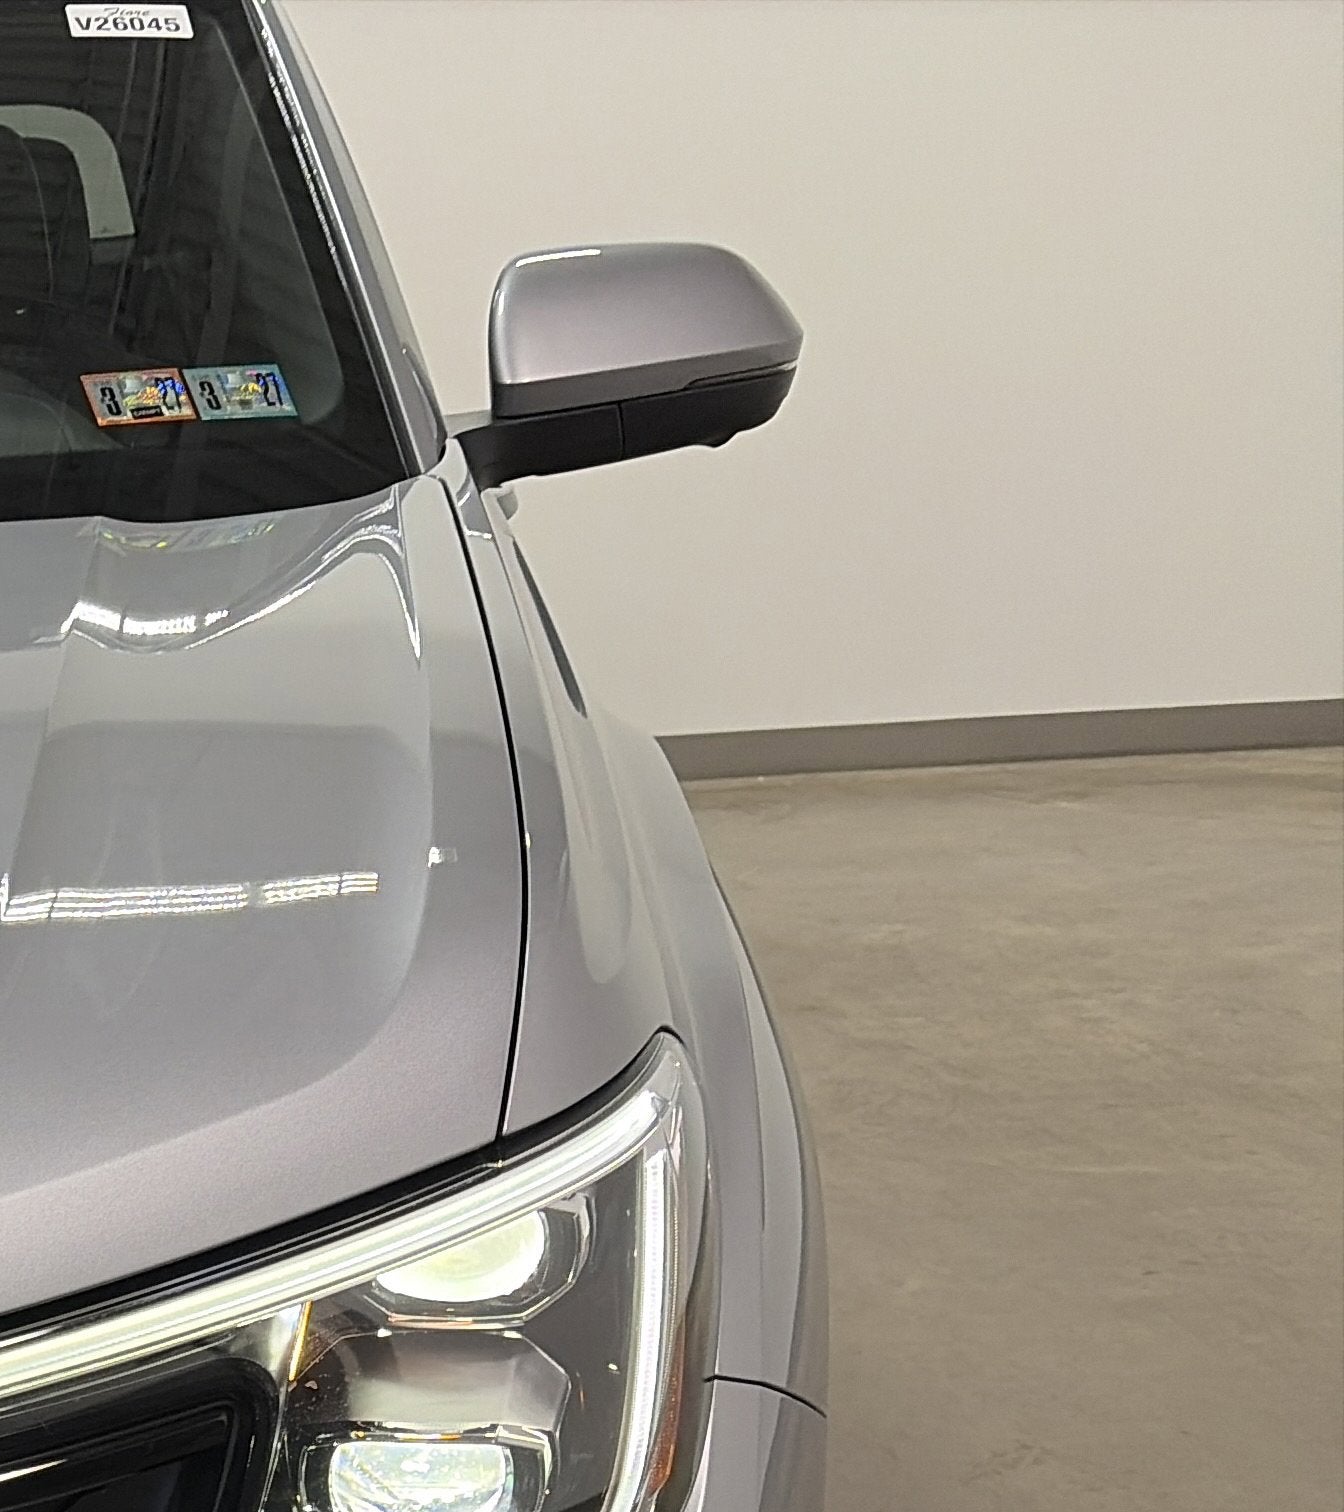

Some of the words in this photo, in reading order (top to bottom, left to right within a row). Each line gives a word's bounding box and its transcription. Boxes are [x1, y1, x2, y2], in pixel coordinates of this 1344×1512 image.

[74, 17, 181, 32] V26045
[99, 386, 122, 416] 3
[198, 380, 222, 410] 3
